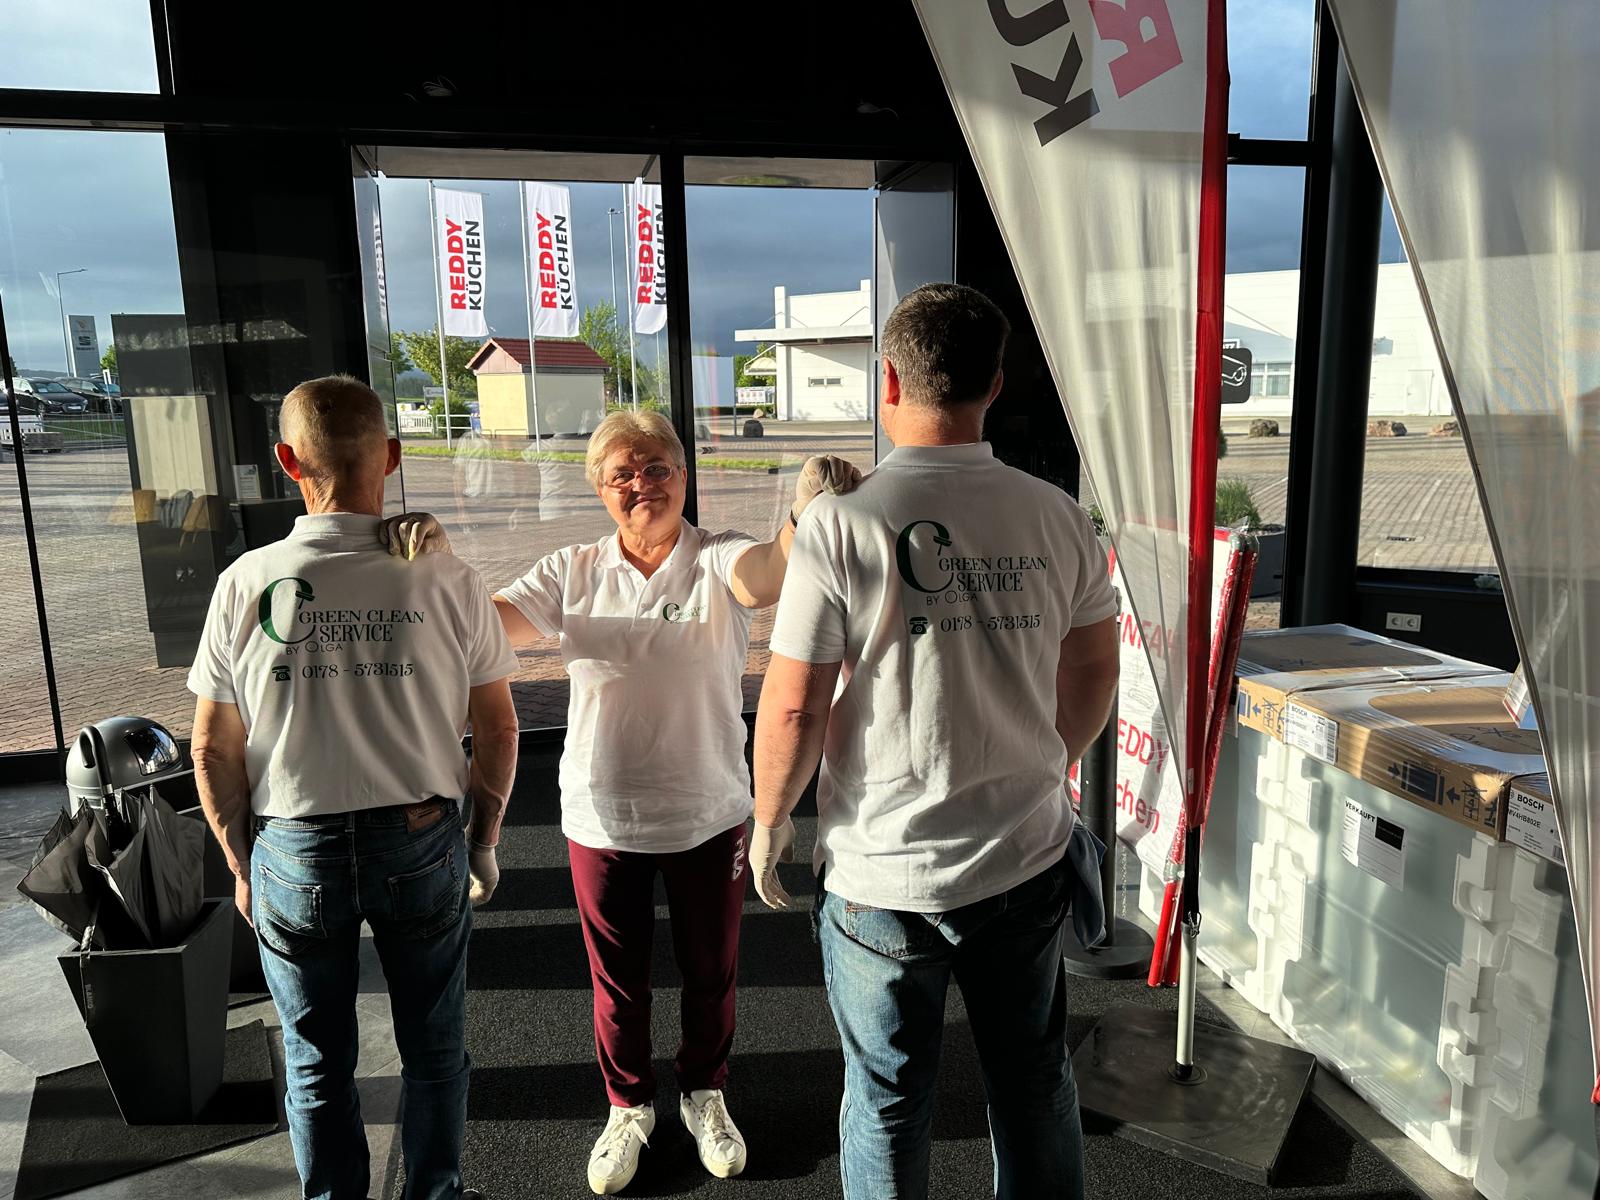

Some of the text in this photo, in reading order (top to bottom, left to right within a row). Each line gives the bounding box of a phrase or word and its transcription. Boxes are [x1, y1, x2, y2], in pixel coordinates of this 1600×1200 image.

[445, 217, 467, 310] REDDY
[535, 211, 558, 309] REDDY
[553, 214, 574, 310] KÜCHEN
[637, 203, 655, 305] REDDY
[465, 220, 482, 311] KÜCHEN
[939, 556, 1048, 571] GREEN CLEAN
[956, 572, 1023, 592] SERVICE
[926, 591, 978, 606] BY OLGA
[299, 610, 424, 624] GREEN CLEAN
[940, 615, 972, 632] 0178
[987, 614, 1040, 631] 5731515
[320, 624, 393, 643] SERVICE
[286, 640, 343, 655] BY OLGA
[302, 664, 339, 679] 0178
[354, 663, 414, 678] 5731515
[1345, 800, 1376, 822] VERKAUFT
[1517, 794, 1545, 811] BOSCH
